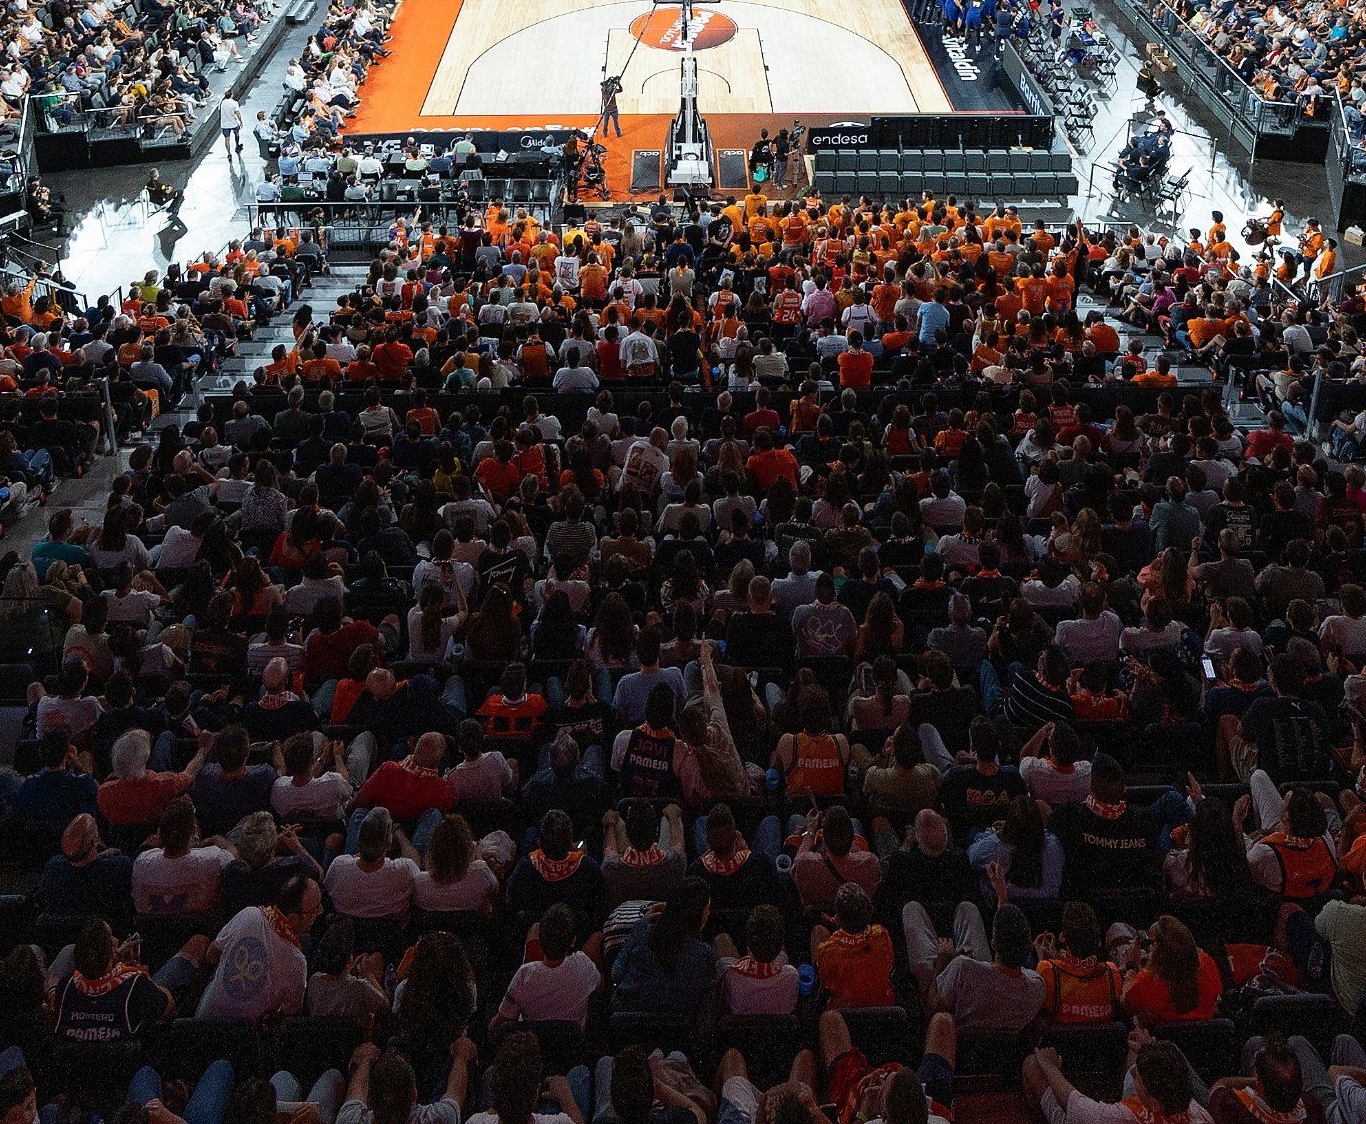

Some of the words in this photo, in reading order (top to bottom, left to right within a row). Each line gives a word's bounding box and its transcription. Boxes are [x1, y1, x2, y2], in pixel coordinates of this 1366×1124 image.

[812, 133, 868, 146] endesa
[781, 308, 795, 320] 24
[629, 752, 668, 771] PAMESA
[1082, 832, 1119, 849] TOMMY
[1120, 837, 1147, 849] JEANS
[70, 1010, 115, 1022] MONTERO
[66, 1025, 121, 1042] PAMESA
